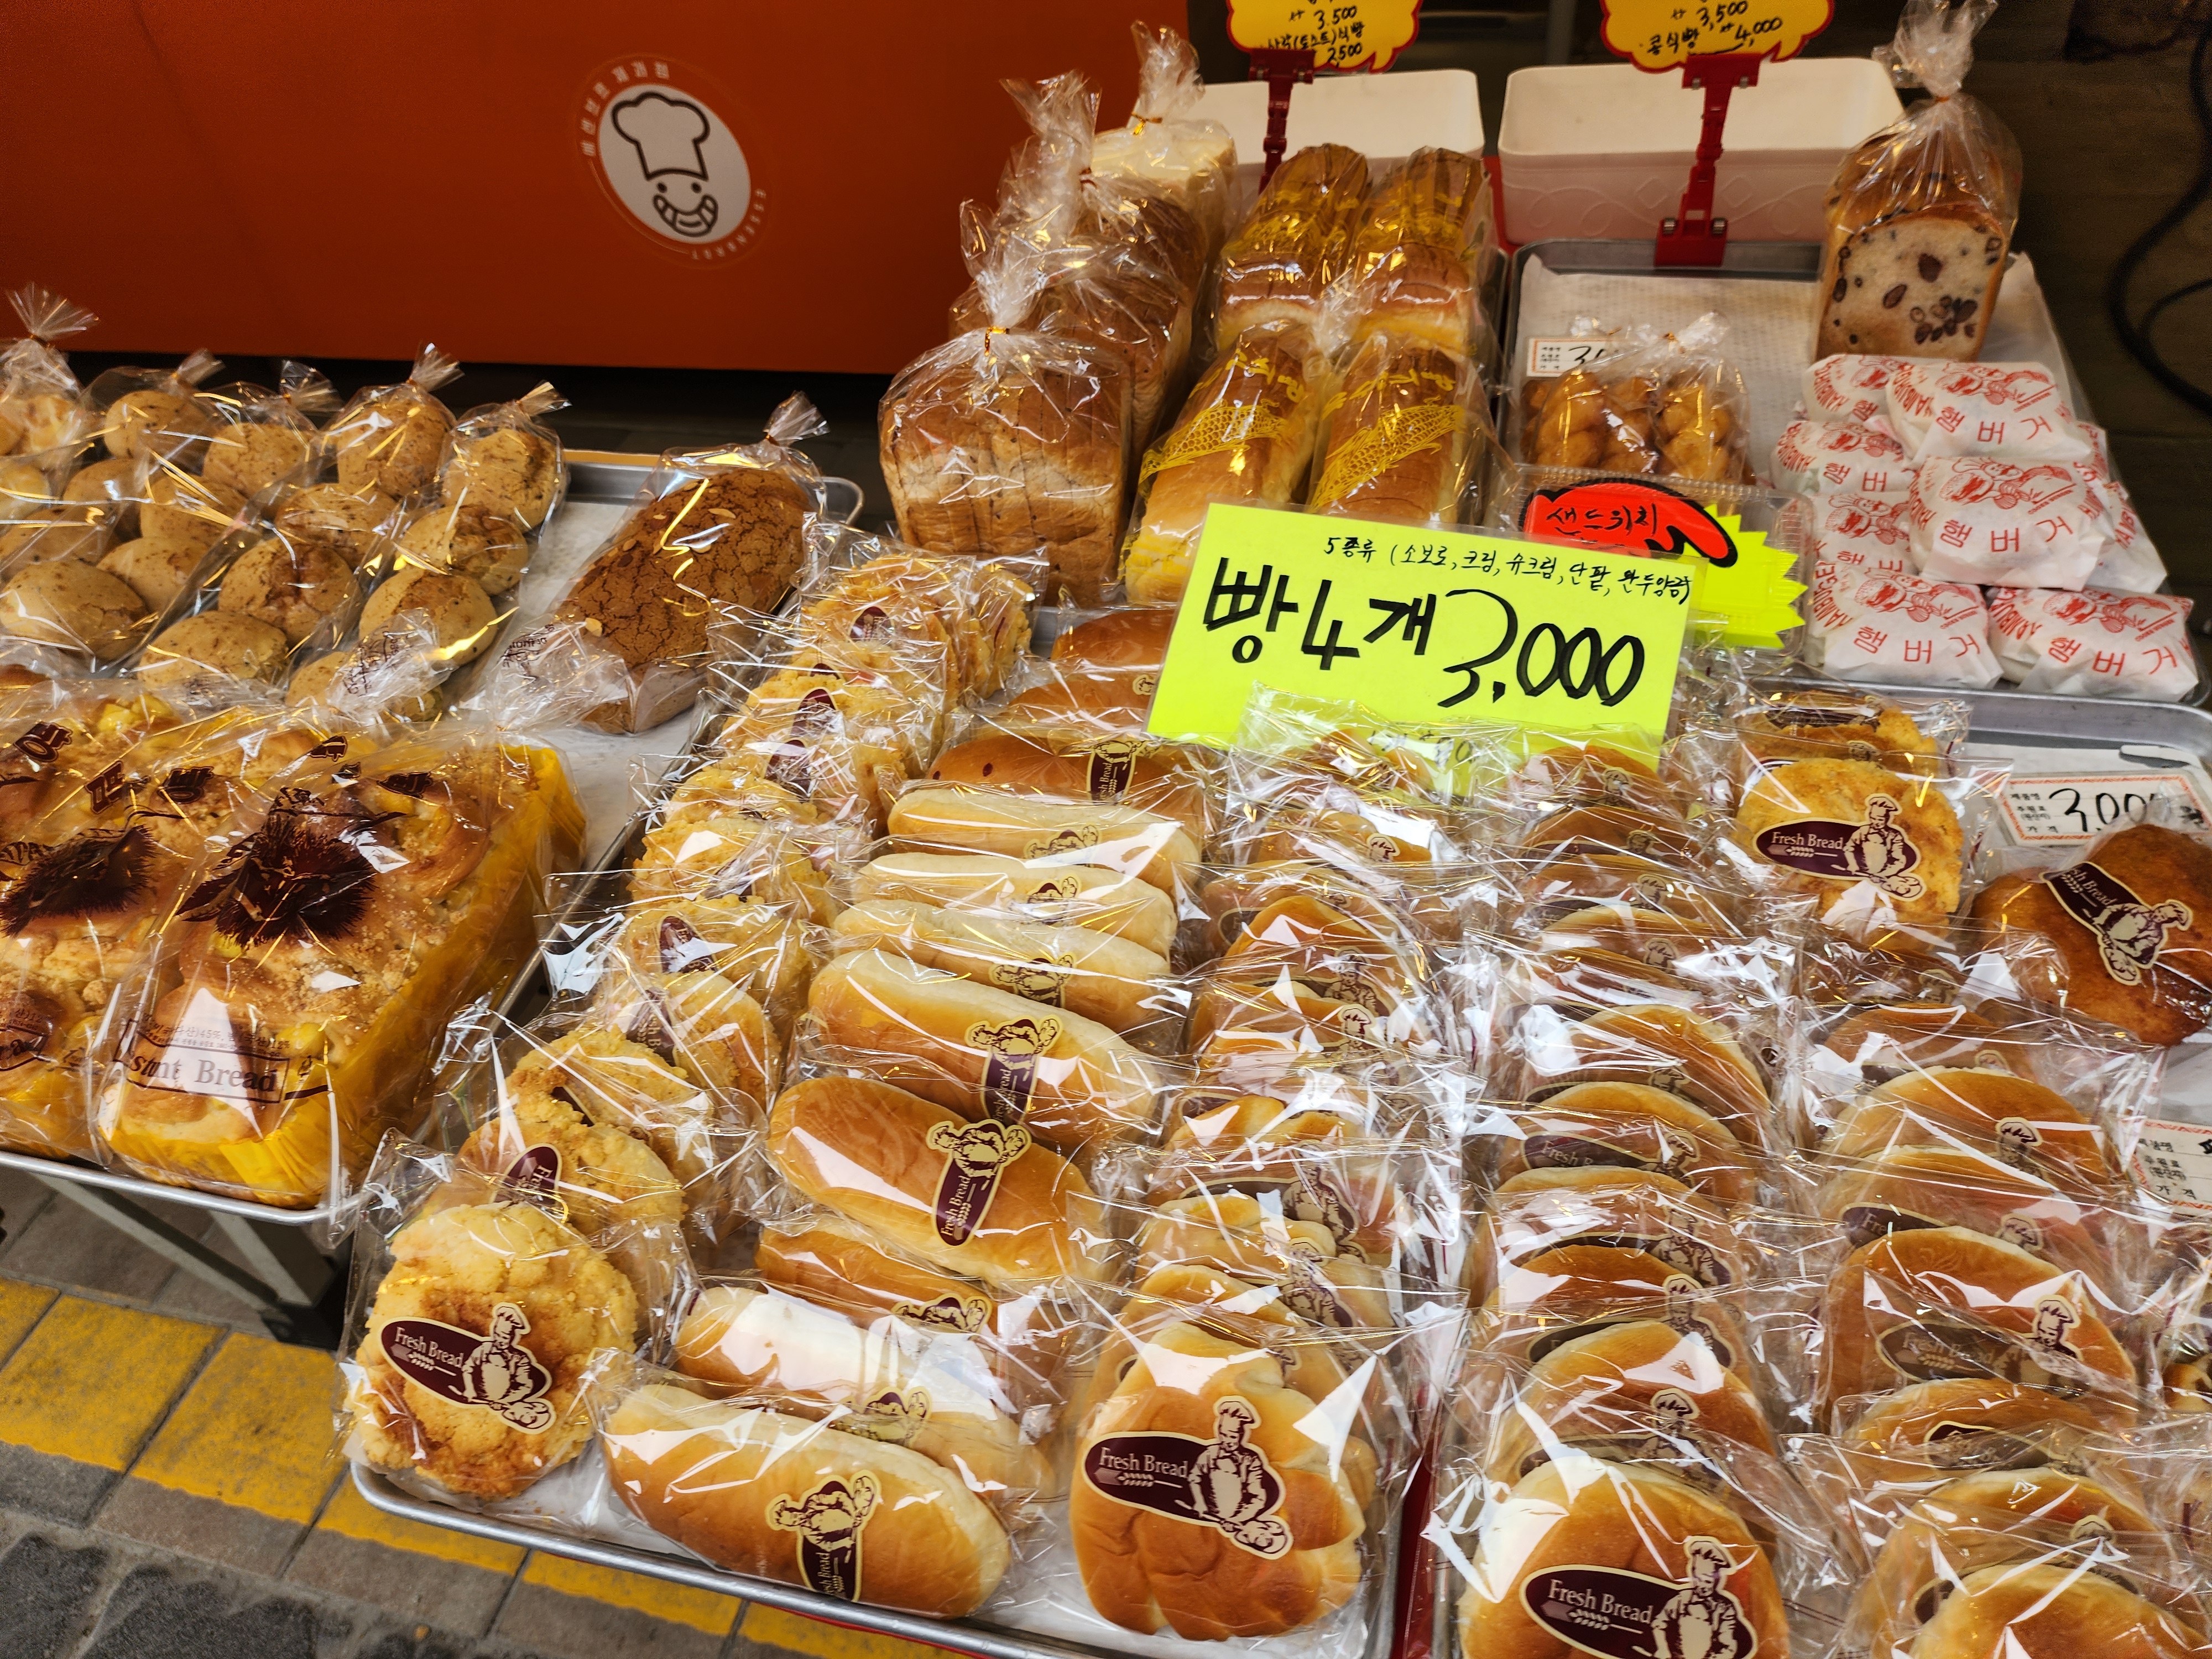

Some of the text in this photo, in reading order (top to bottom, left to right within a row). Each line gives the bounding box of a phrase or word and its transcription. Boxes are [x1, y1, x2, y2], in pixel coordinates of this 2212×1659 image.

[1734, 17, 1783, 47] 4,000
[1936, 405, 2053, 444] 햄버거
[1823, 462, 1914, 492] 햄버
[1547, 503, 1657, 536] 샌드위치
[1940, 515, 2073, 552] 햄버거
[1438, 588, 1645, 707] 3,000
[1853, 625, 1980, 664] 햄버거
[2048, 637, 2178, 676] 햄버거
[1099, 762, 1113, 782] Bread
[1771, 832, 1844, 851] Fresh Bread
[2084, 879, 2118, 906] Bread
[195, 1059, 278, 1092] Bread
[949, 1175, 971, 1207] Bread
[941, 1210, 958, 1237] Fresh
[1861, 1212, 1886, 1232] Fre
[394, 1326, 464, 1369] Fresh Bread
[1099, 1447, 1189, 1479] Fresh Bread
[815, 1552, 831, 1577] Bread
[1548, 1579, 1654, 1625] Fresh Bread
